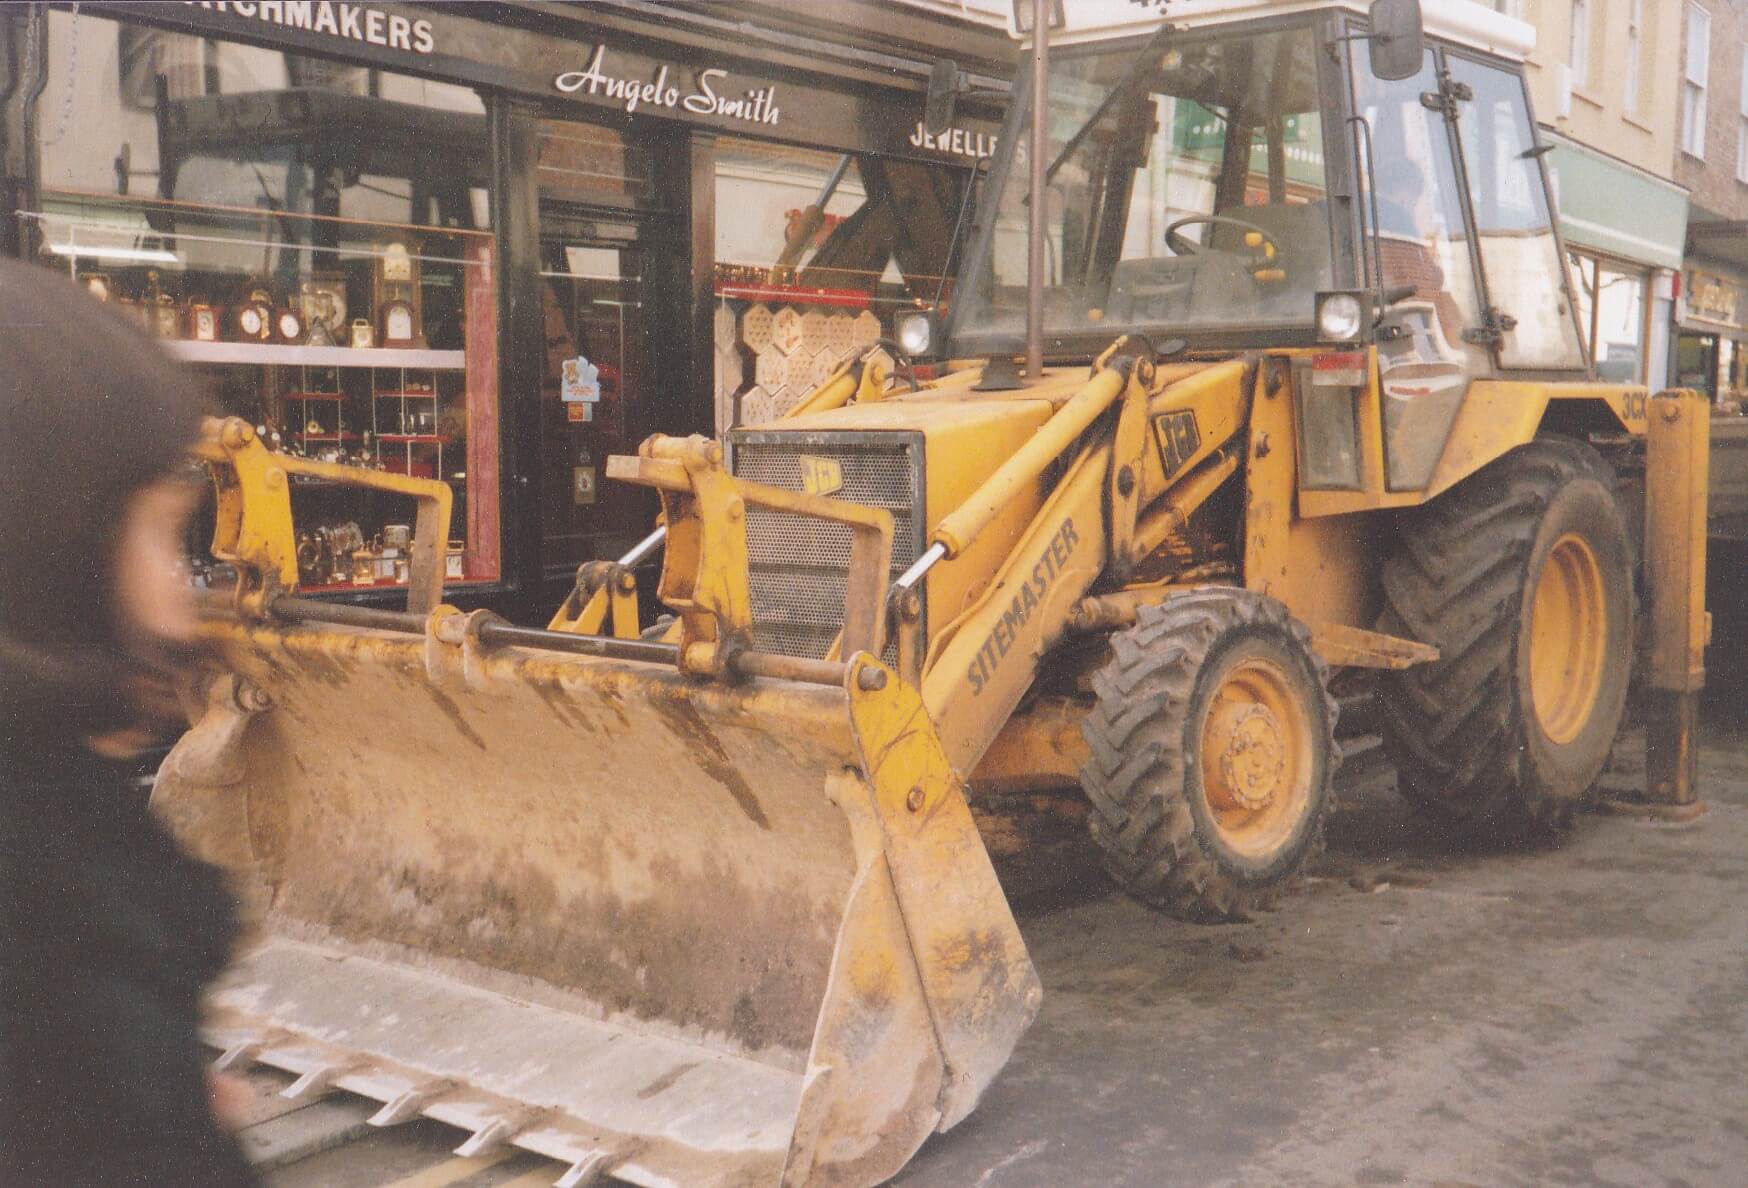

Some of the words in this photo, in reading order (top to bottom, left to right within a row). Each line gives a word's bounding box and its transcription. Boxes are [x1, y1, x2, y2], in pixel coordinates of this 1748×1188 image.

[555, 44, 680, 113] Angelo
[684, 68, 779, 126] Smith
[1622, 391, 1647, 420] 3CX
[1159, 412, 1199, 474] JCB
[967, 516, 1079, 697] SITEMASTER
